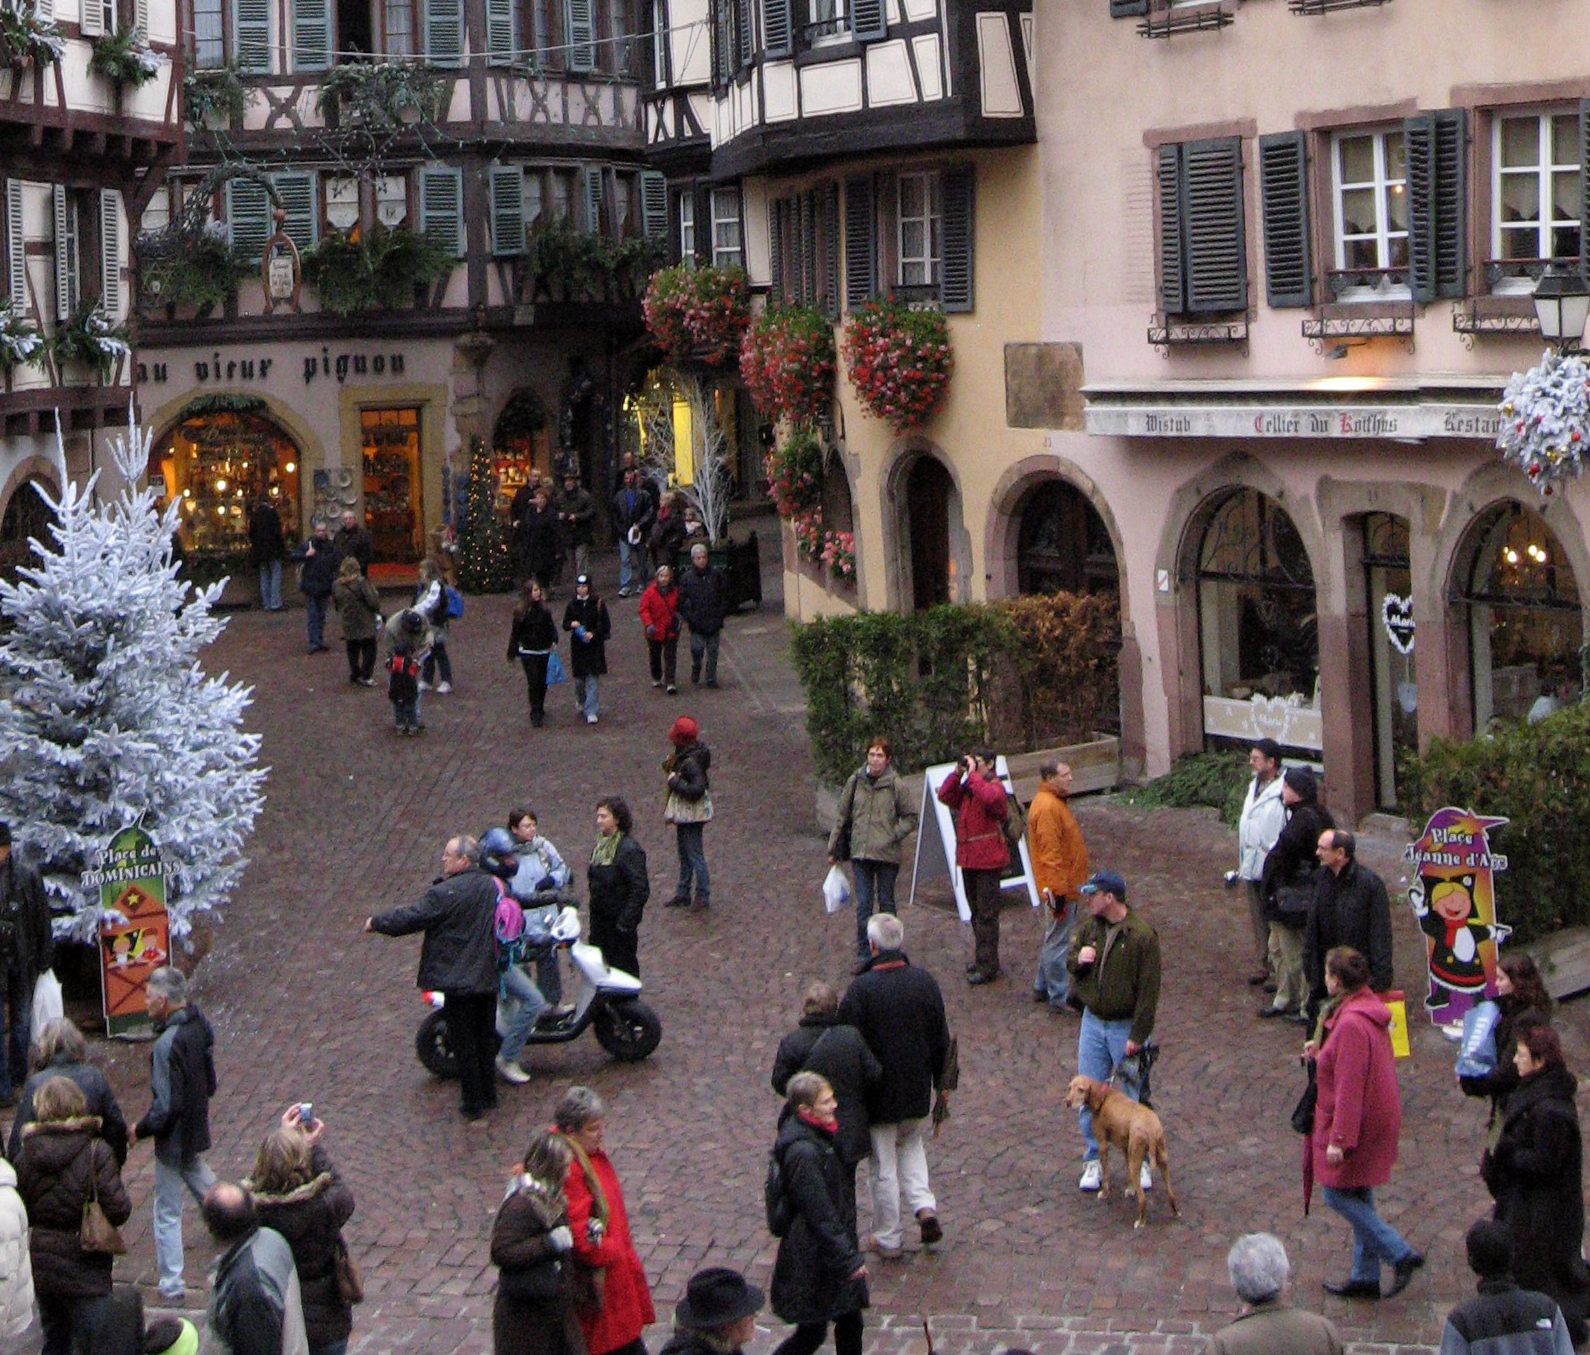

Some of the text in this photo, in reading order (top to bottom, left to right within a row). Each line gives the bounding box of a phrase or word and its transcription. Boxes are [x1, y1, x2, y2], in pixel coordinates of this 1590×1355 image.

[304, 347, 405, 385] pignon
[1146, 413, 1191, 432] Wistub
[1254, 413, 1300, 433] Cellier
[1310, 413, 1328, 433] du
[1444, 412, 1502, 434] Restau
[1431, 827, 1473, 845] Place
[95, 848, 137, 868] Place
[1405, 844, 1509, 871] Jeanne d'Arc
[81, 861, 181, 888] DOMINICAINS
